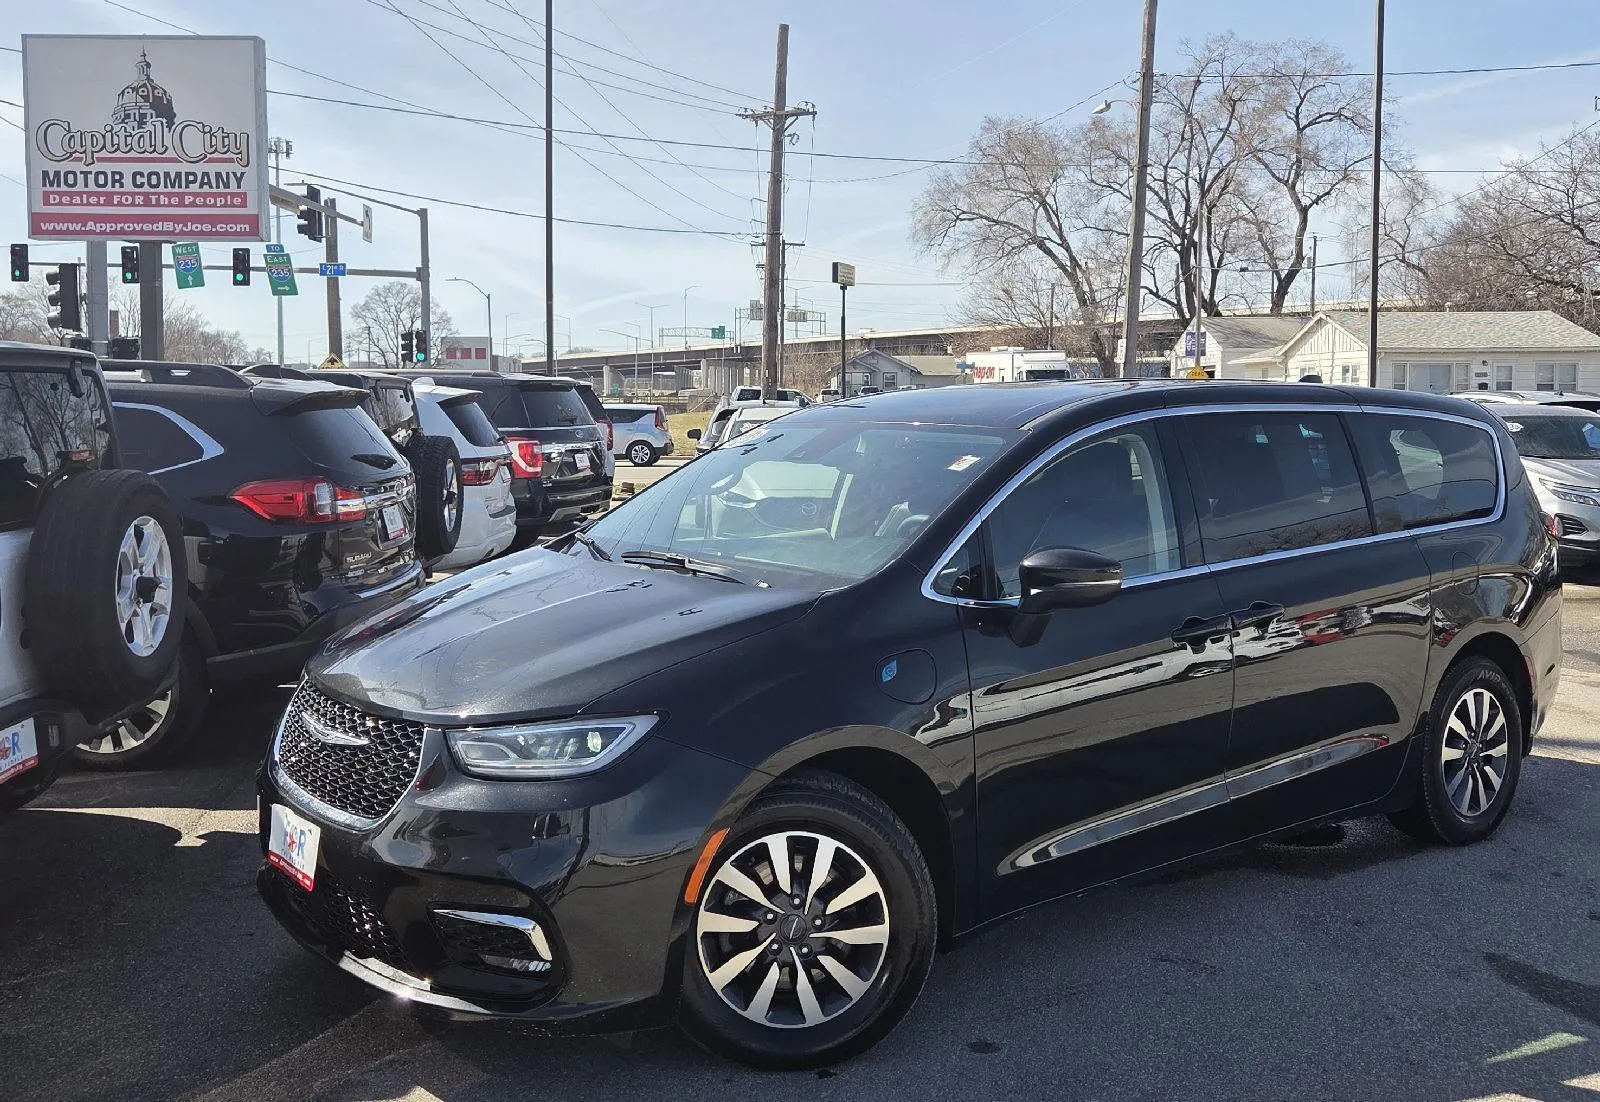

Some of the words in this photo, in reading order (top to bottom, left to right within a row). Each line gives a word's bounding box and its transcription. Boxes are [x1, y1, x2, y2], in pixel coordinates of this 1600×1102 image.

[36, 119, 169, 166] Capital
[172, 120, 250, 167] City
[42, 170, 125, 189] MOTOR
[132, 171, 246, 190] COMPANY
[49, 194, 106, 205] Dealer
[113, 195, 144, 205] FOR
[149, 195, 179, 205] The
[40, 221, 250, 233] www.ApprovedByJoe.com
[175, 246, 196, 254] WEST
[179, 259, 198, 269] 235
[271, 268, 290, 277] 235
